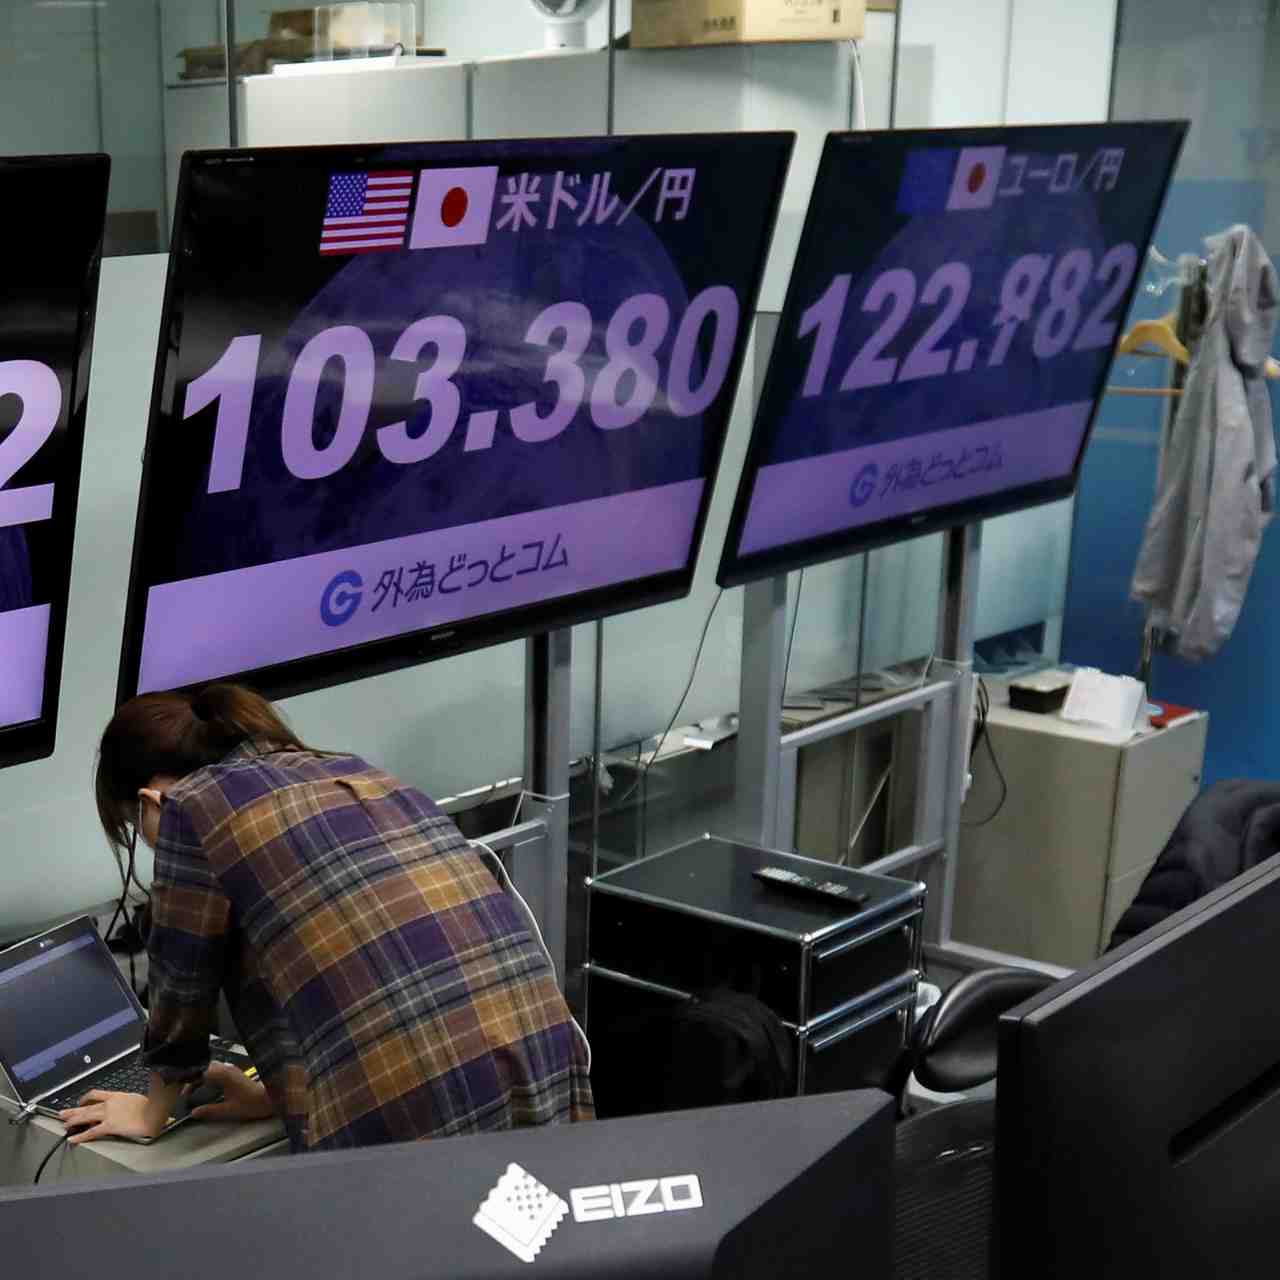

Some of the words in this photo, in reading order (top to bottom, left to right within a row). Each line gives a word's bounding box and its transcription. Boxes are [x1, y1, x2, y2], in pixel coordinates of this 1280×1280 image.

[797, 242, 1137, 399] 122.982
[183, 285, 740, 494] 103.380
[371, 534, 569, 613] 外為どっとコム
[570, 1174, 703, 1222] EIZO
